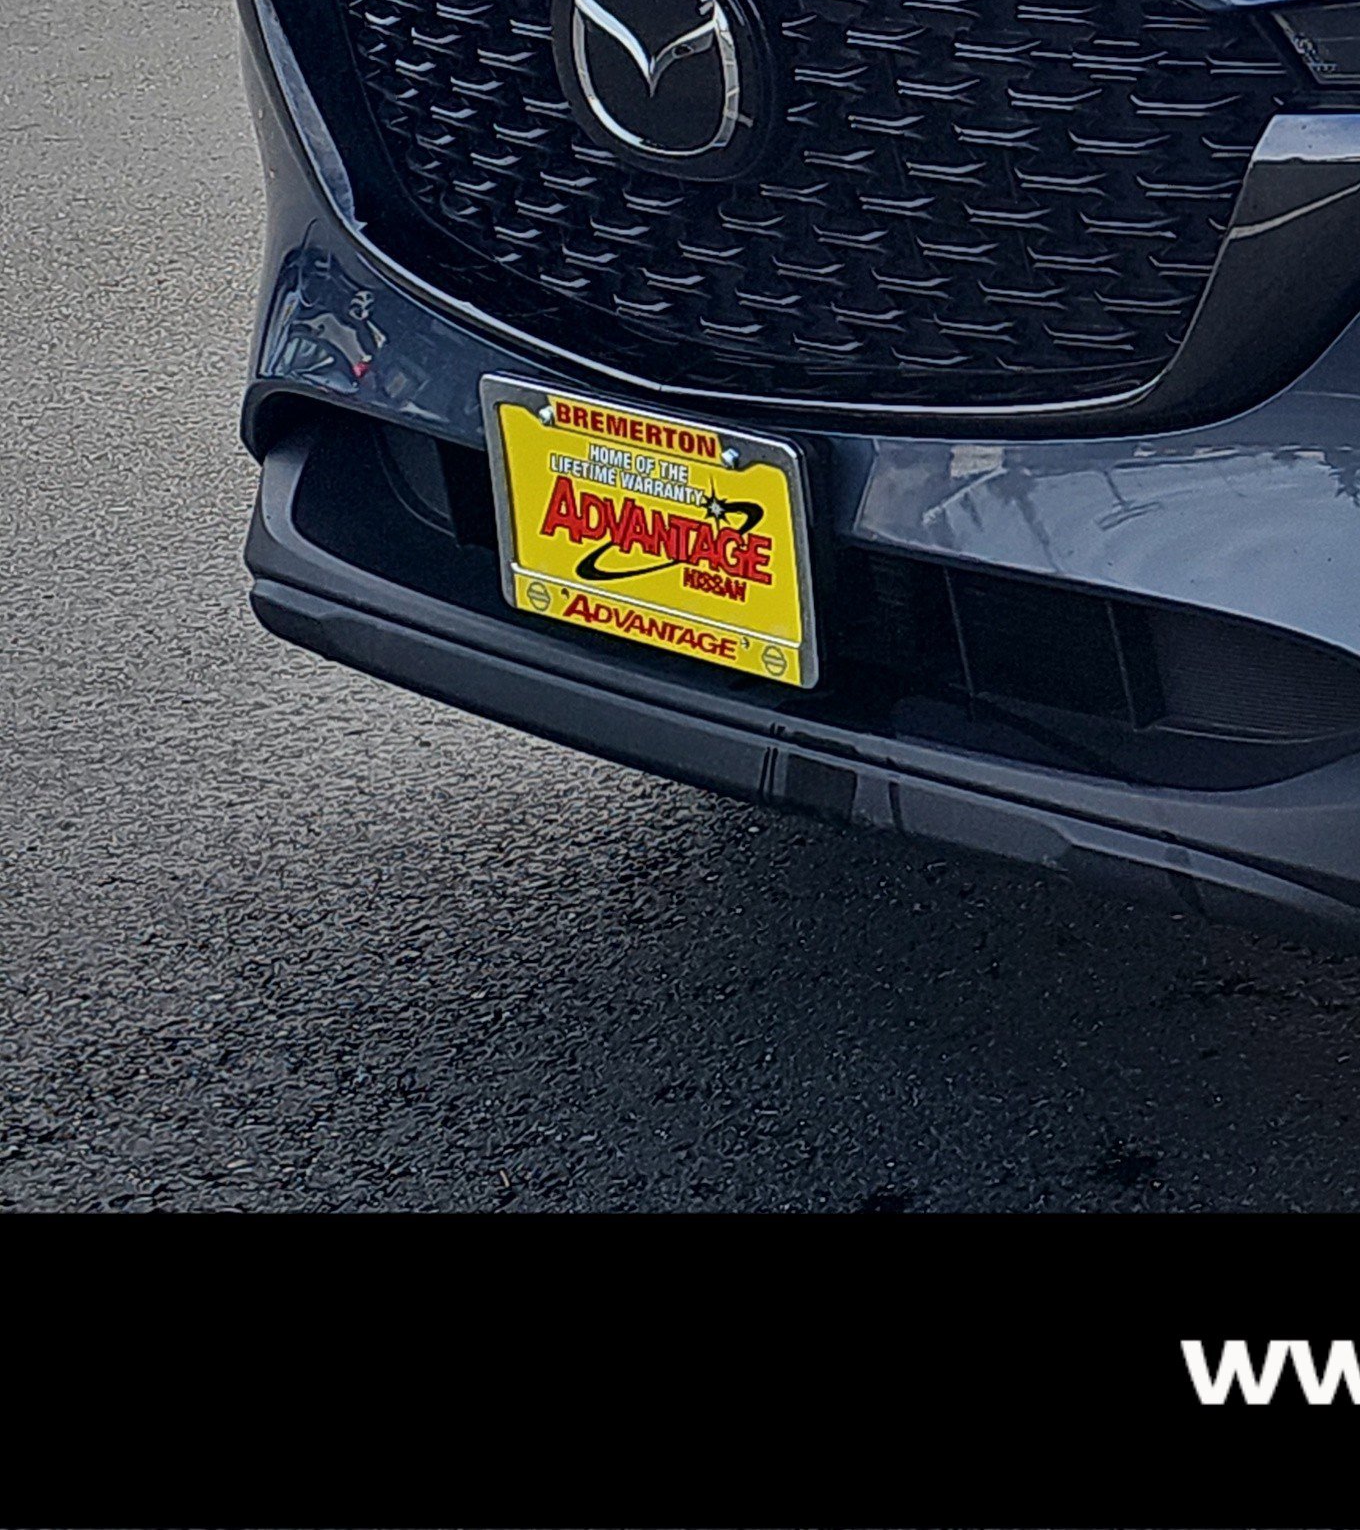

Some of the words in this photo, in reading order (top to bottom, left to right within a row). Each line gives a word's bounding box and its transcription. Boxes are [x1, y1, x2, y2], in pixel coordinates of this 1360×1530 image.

[554, 401, 718, 459] BREMERTON
[549, 453, 617, 486] LIFETIME
[619, 471, 706, 507] WARRANTY
[589, 444, 632, 470] HOME
[635, 453, 656, 475] OF
[658, 461, 689, 484] THE
[540, 475, 773, 587] ADVANTAGE
[682, 567, 748, 603] NISSAN
